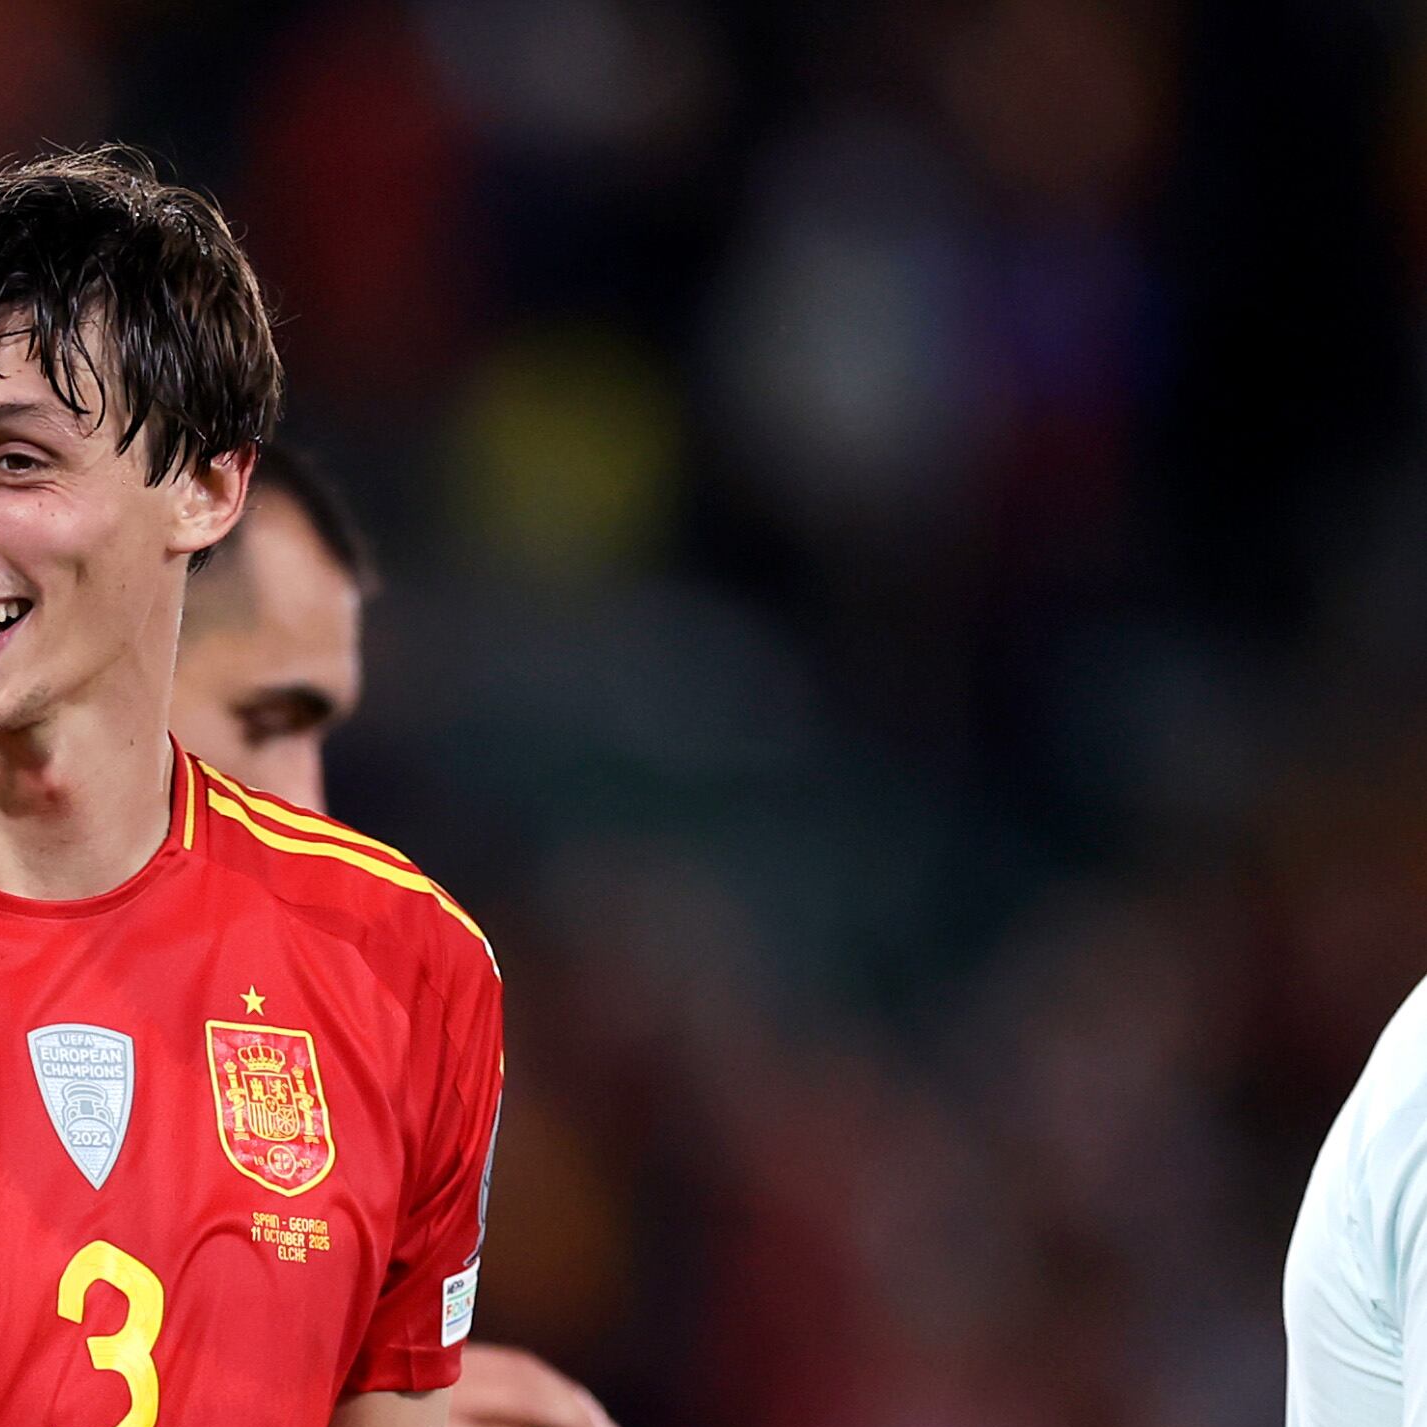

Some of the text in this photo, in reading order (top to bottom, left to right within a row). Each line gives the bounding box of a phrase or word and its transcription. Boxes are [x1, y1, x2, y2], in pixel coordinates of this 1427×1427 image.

[60, 1034, 94, 1047] UEFA
[40, 1046, 123, 1063] EUROPEAN
[42, 1062, 125, 1079] CHAMPIONS
[71, 1131, 113, 1146] 2024
[252, 1211, 280, 1229] SPAIN
[288, 1216, 328, 1235] GEORGIA
[250, 1226, 330, 1251] 11 OCTOBER 2025
[277, 1244, 307, 1263] ELCHE
